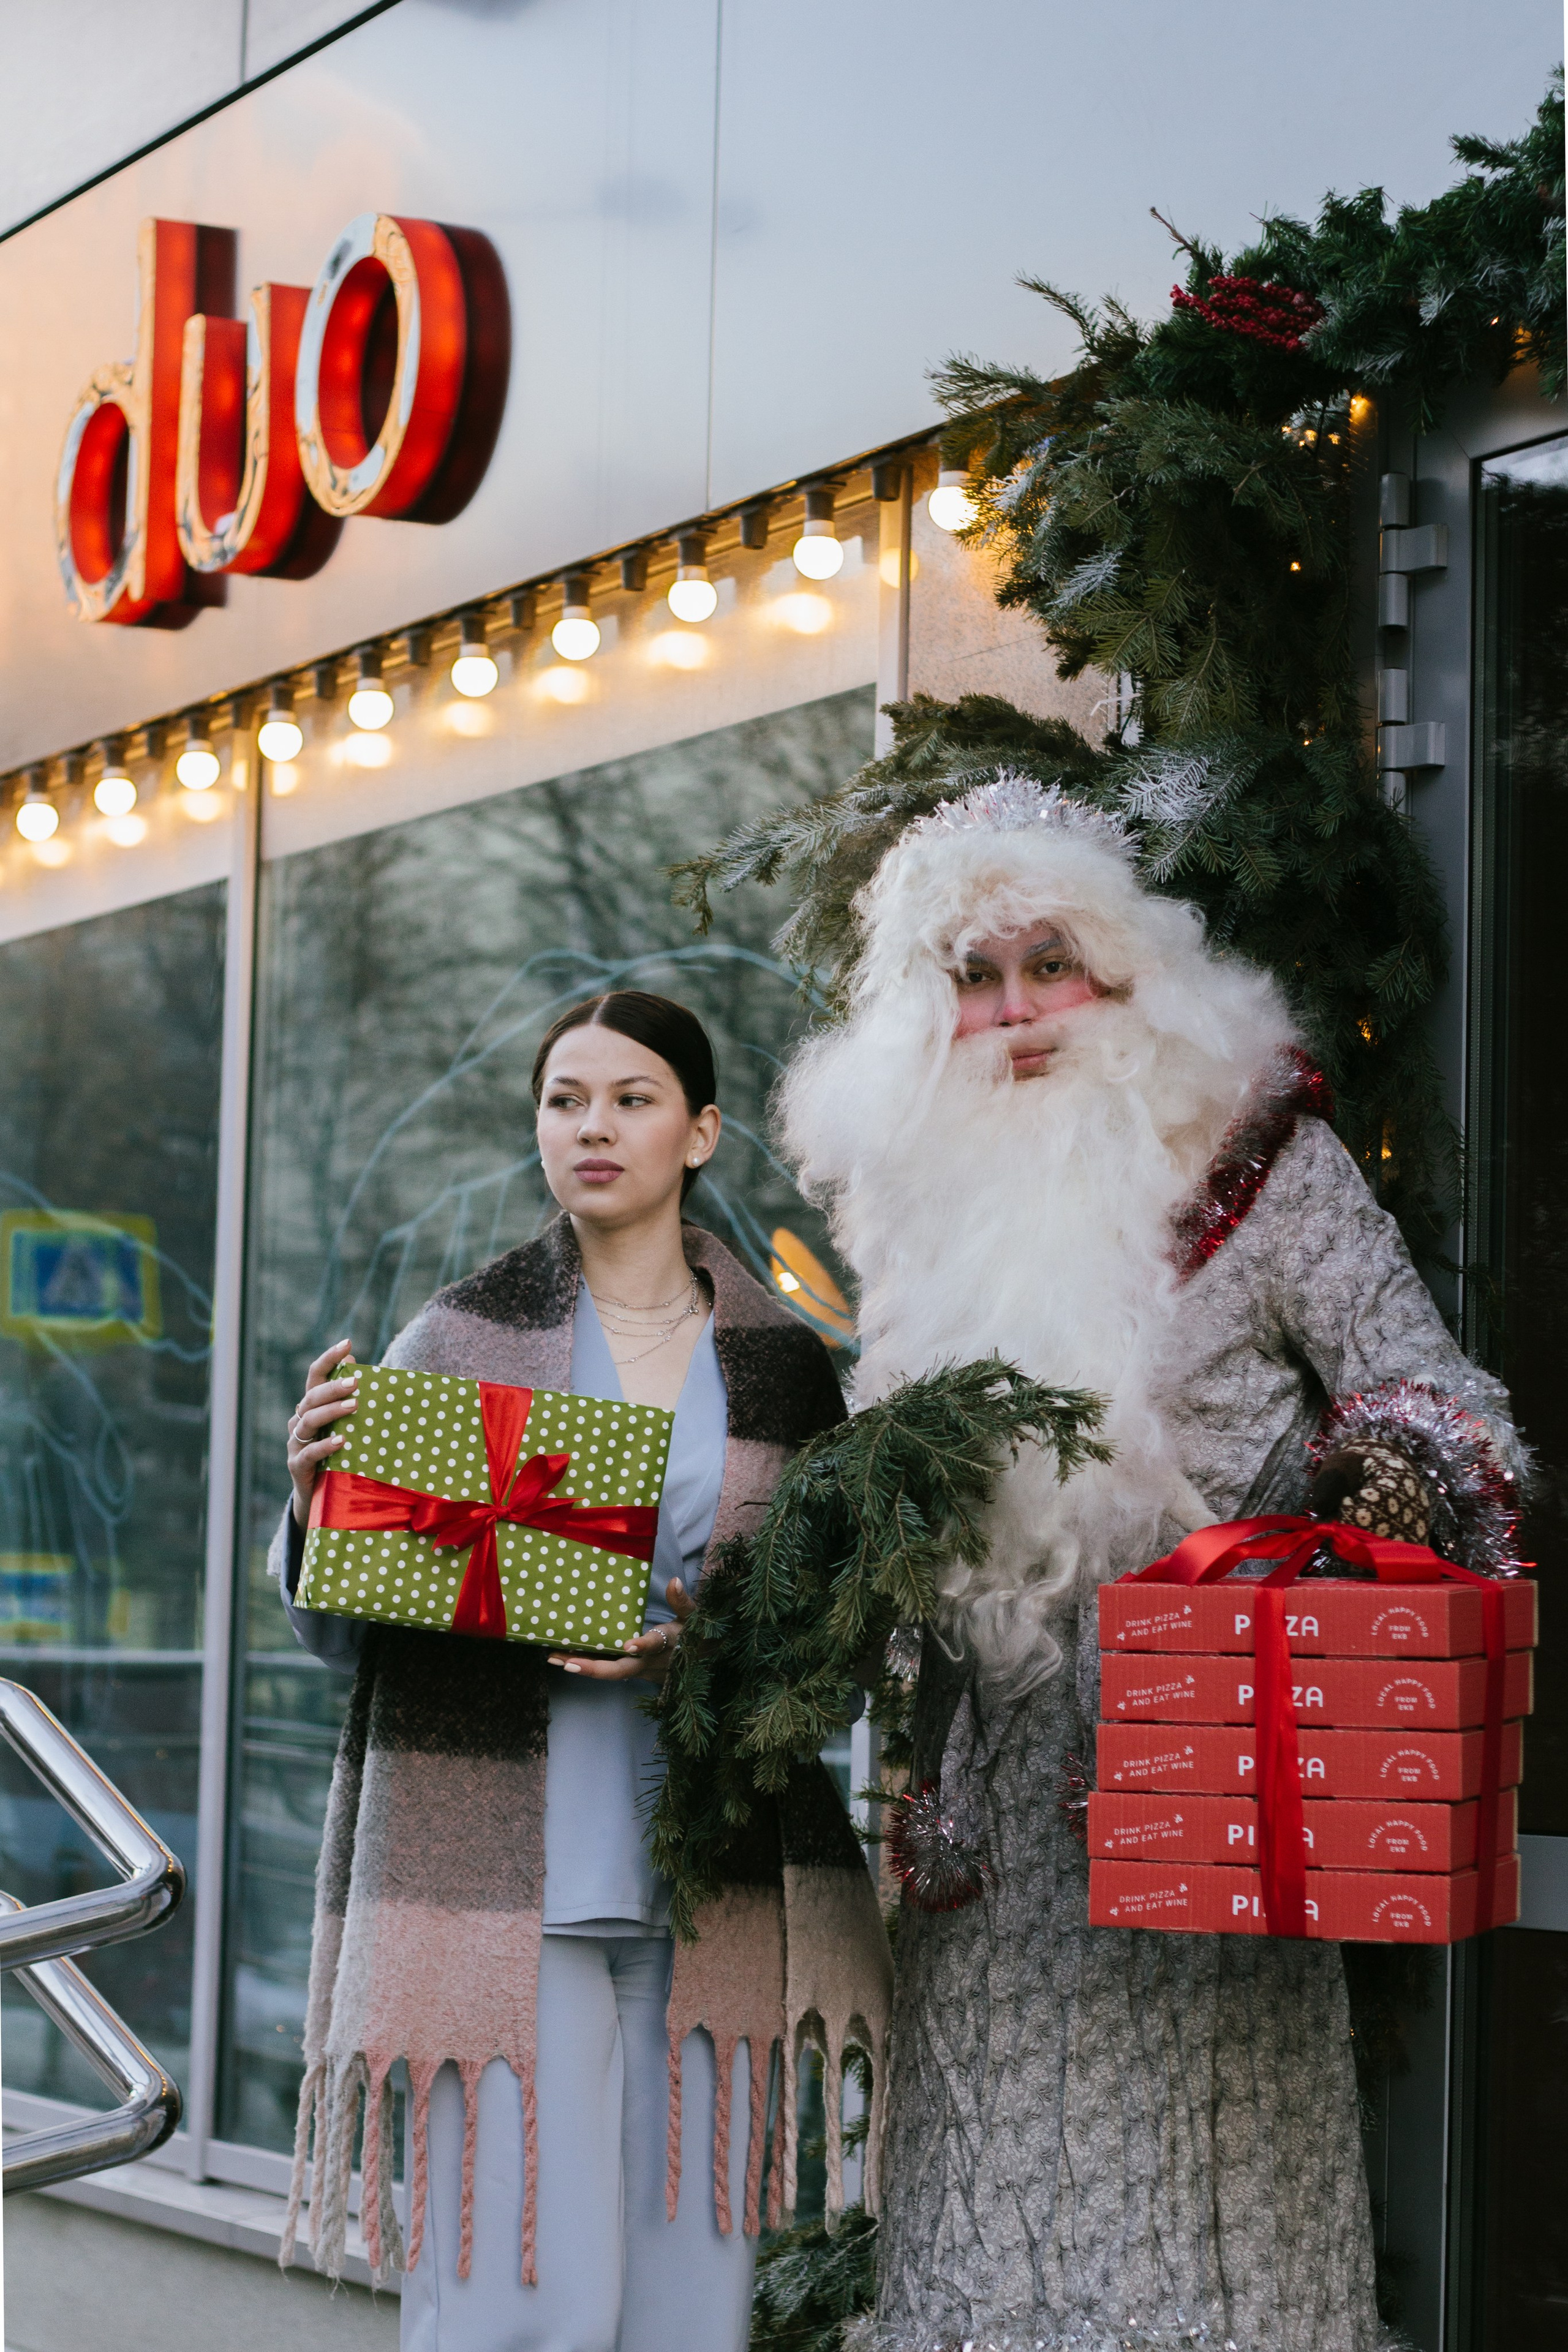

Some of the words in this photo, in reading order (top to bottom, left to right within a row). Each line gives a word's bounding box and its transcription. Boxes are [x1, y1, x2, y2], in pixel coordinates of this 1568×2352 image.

[54, 211, 469, 625] duo
[1154, 1612, 1180, 1623] PIZZA
[1235, 1615, 1319, 1637] PZA
[1371, 1613, 1387, 1635] LOCAL
[1388, 1607, 1415, 1616] HAPPY
[1415, 1616, 1428, 1637] FOOD
[1131, 1628, 1149, 1637] AND
[1152, 1624, 1168, 1634] EAT
[1170, 1621, 1193, 1629] WINE
[1126, 1688, 1153, 1697] DRINK
[1156, 1682, 1182, 1692] PIZZA
[1238, 1684, 1323, 1708] PZA
[1376, 1684, 1393, 1707] LOCAL
[1395, 1678, 1423, 1688] HAPPY
[1422, 1687, 1436, 1709] FOOD
[1133, 1698, 1151, 1706] AND
[1153, 1694, 1170, 1703] EAT
[1123, 1759, 1151, 1768] DRINK
[1154, 1752, 1181, 1763] PIZZA
[1129, 1768, 1148, 1777] AND
[1152, 1764, 1168, 1774] EAT
[1171, 1761, 1194, 1770] WINE
[1379, 1754, 1396, 1777] LOCAL
[1397, 1749, 1427, 1759] HAPPY
[1426, 1758, 1439, 1780] FOOD
[1114, 1826, 1142, 1836] DRINK
[1144, 1821, 1170, 1832] PIZZA
[1228, 1824, 1314, 1849] PIA
[1368, 1825, 1385, 1849] LOCAL
[1386, 1820, 1414, 1830] HAPPY
[1414, 1830, 1428, 1851] FOOD
[1120, 1836, 1139, 1845] AND
[1142, 1833, 1158, 1842] EAT
[1150, 1890, 1175, 1900] PIZZA
[1125, 1904, 1144, 1913] AND
[1146, 1901, 1163, 1910] EAT
[1166, 1898, 1188, 1907] WINE
[1232, 1894, 1319, 1921] PIA
[1372, 1899, 1389, 1922] LOCAL
[1390, 1894, 1419, 1905] HAPPY
[1418, 1904, 1431, 1926] FOOD
